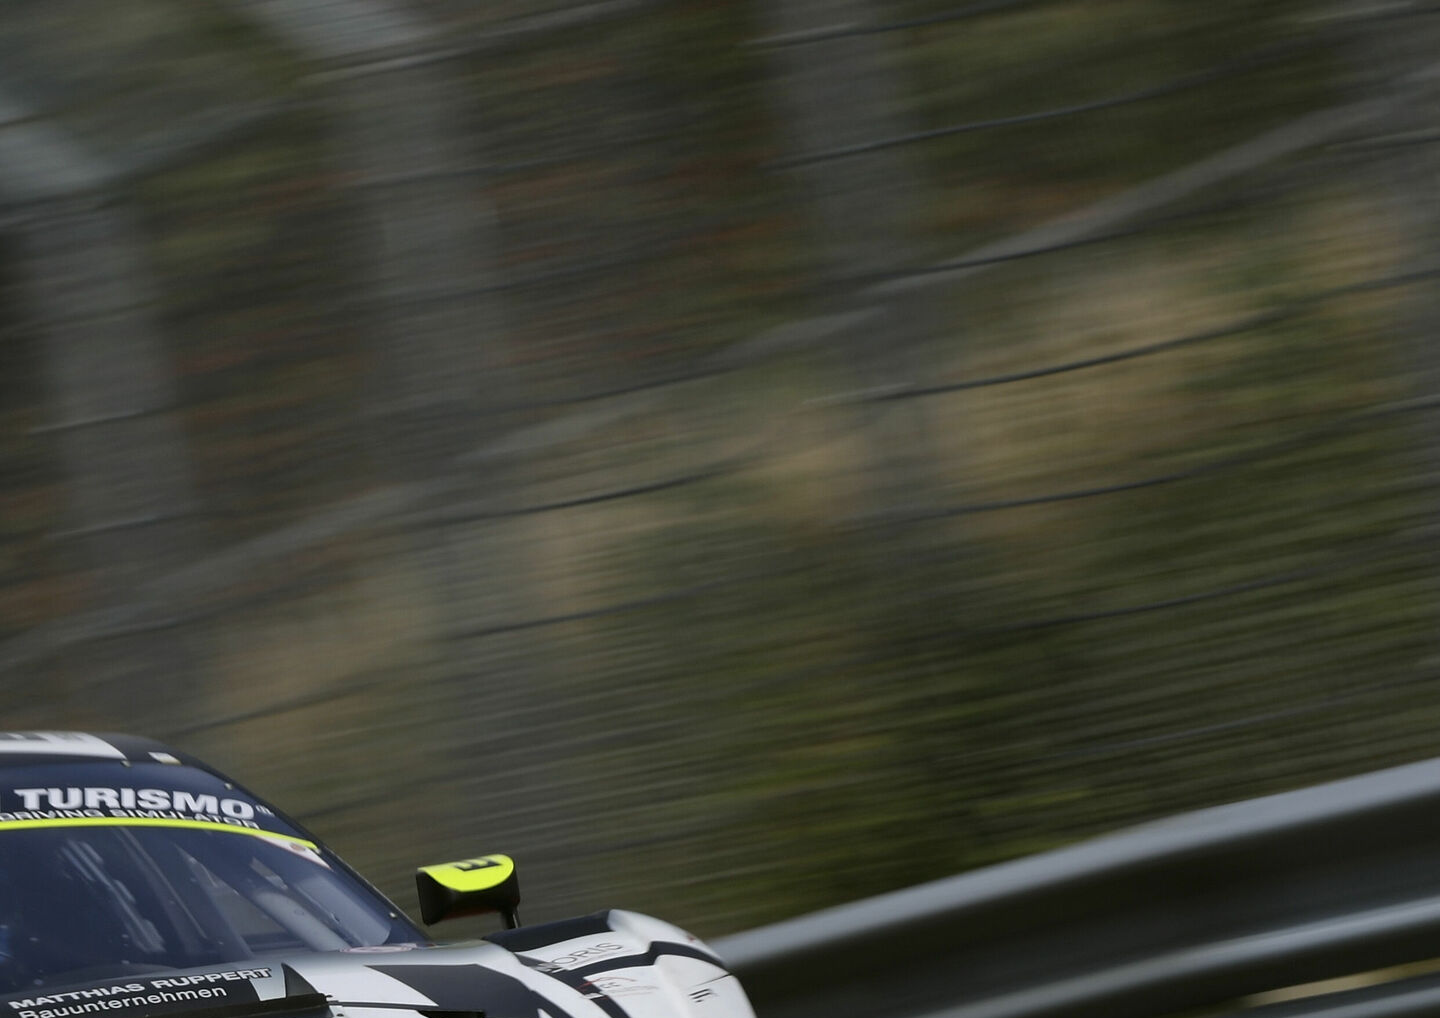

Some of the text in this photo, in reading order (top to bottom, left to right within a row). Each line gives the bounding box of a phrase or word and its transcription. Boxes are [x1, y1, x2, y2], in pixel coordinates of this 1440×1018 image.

[14, 787, 255, 819] TURISMO
[8, 968, 272, 1010] MATTHIAS RUPPERT
